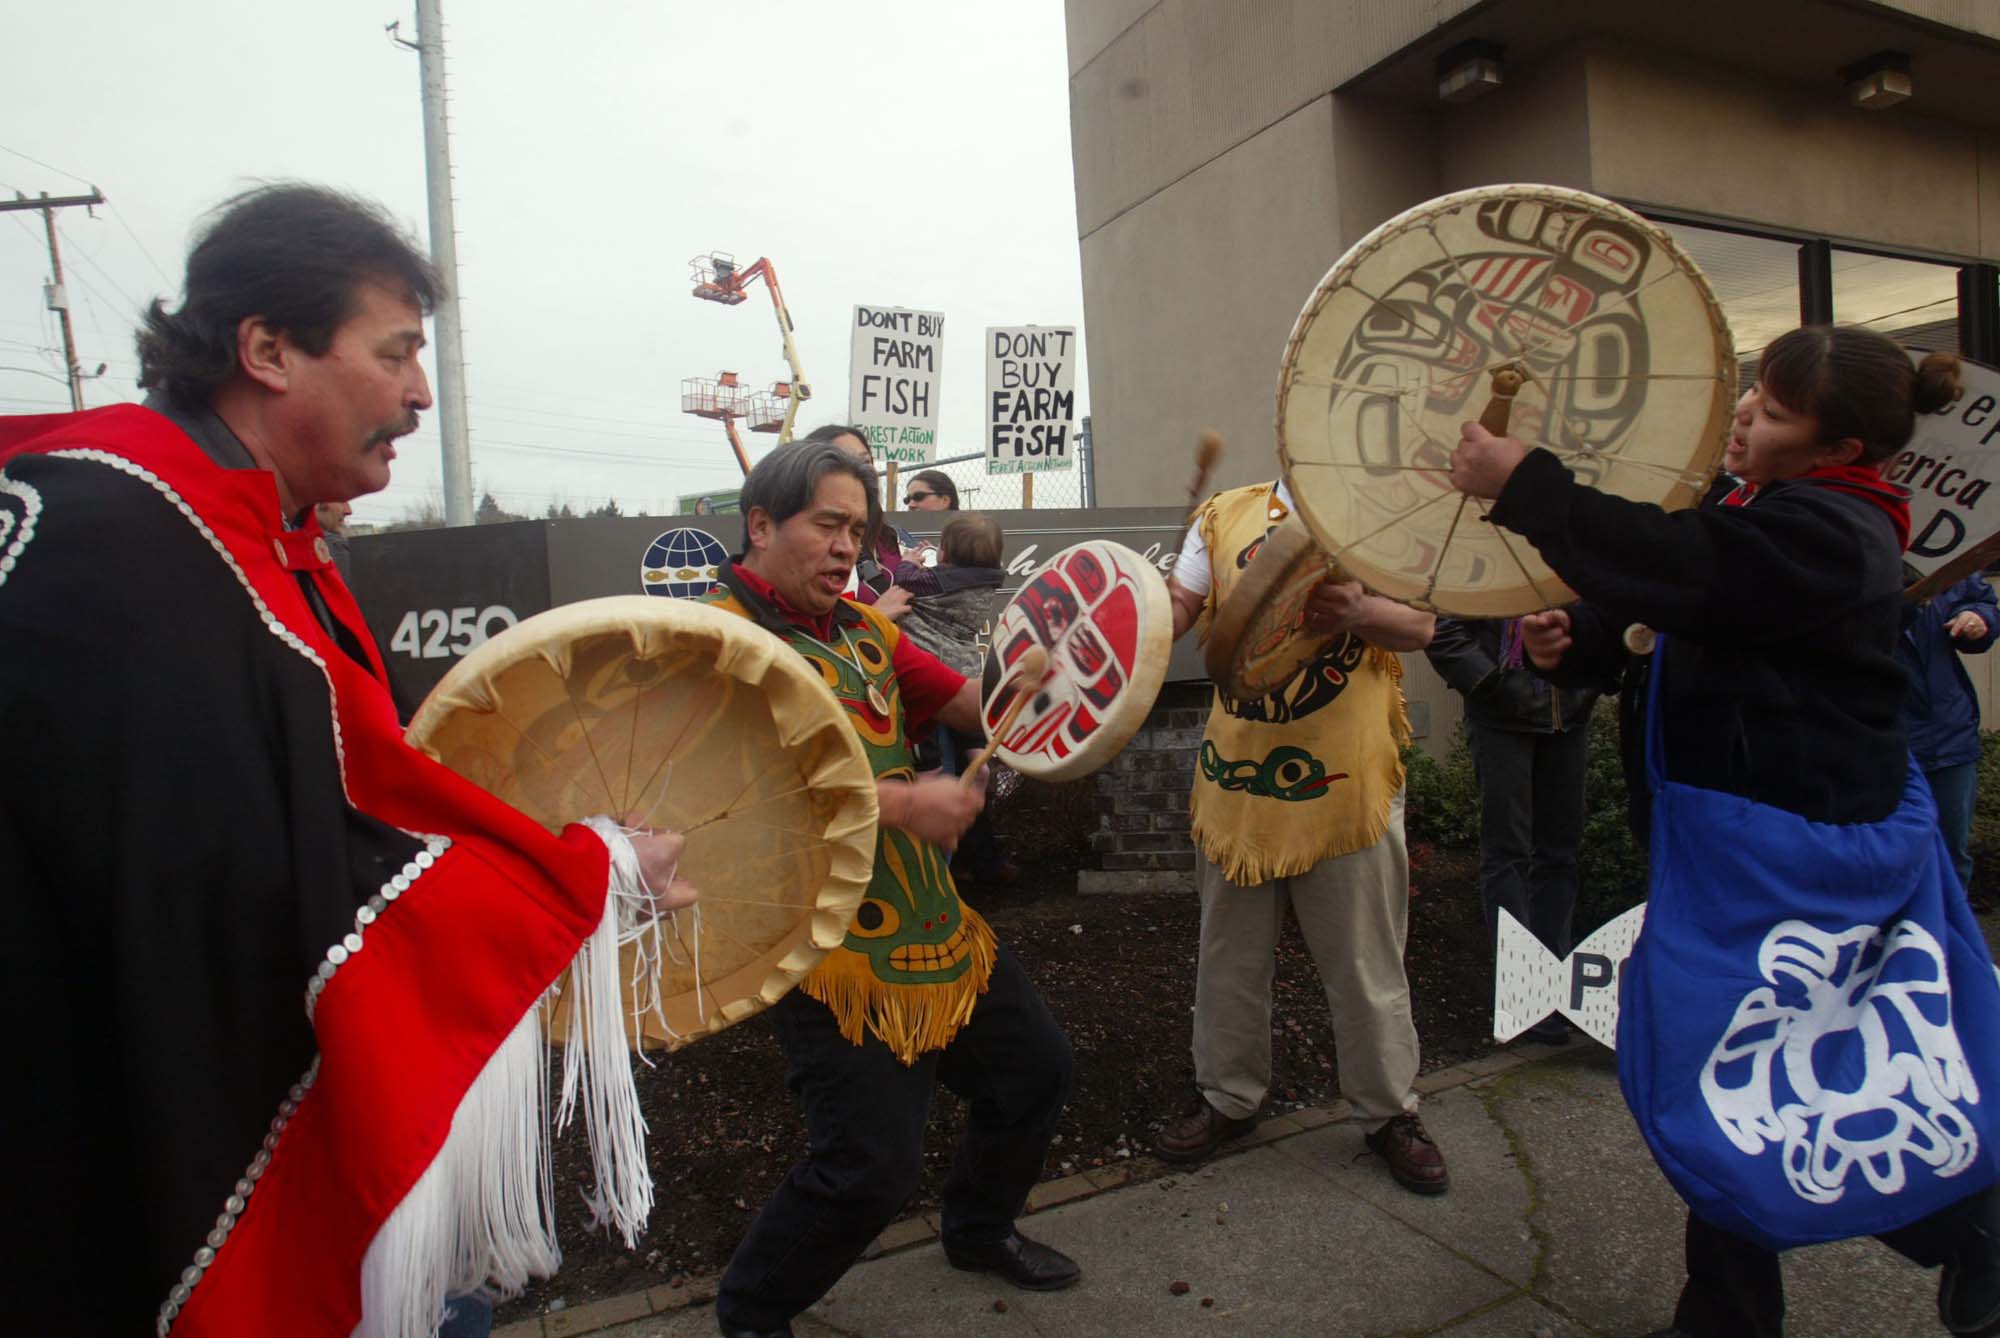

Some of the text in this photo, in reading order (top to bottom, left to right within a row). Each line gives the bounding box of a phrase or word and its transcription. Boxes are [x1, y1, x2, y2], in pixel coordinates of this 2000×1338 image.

[857, 307, 945, 338] DON'T BUY
[873, 337, 934, 372] FARM
[995, 331, 1073, 359] DON'T
[1002, 360, 1062, 388] BUY
[862, 375, 929, 418] FISH
[992, 388, 1074, 424] FARM
[868, 444, 925, 462] TWORK
[1883, 450, 1992, 510] erica
